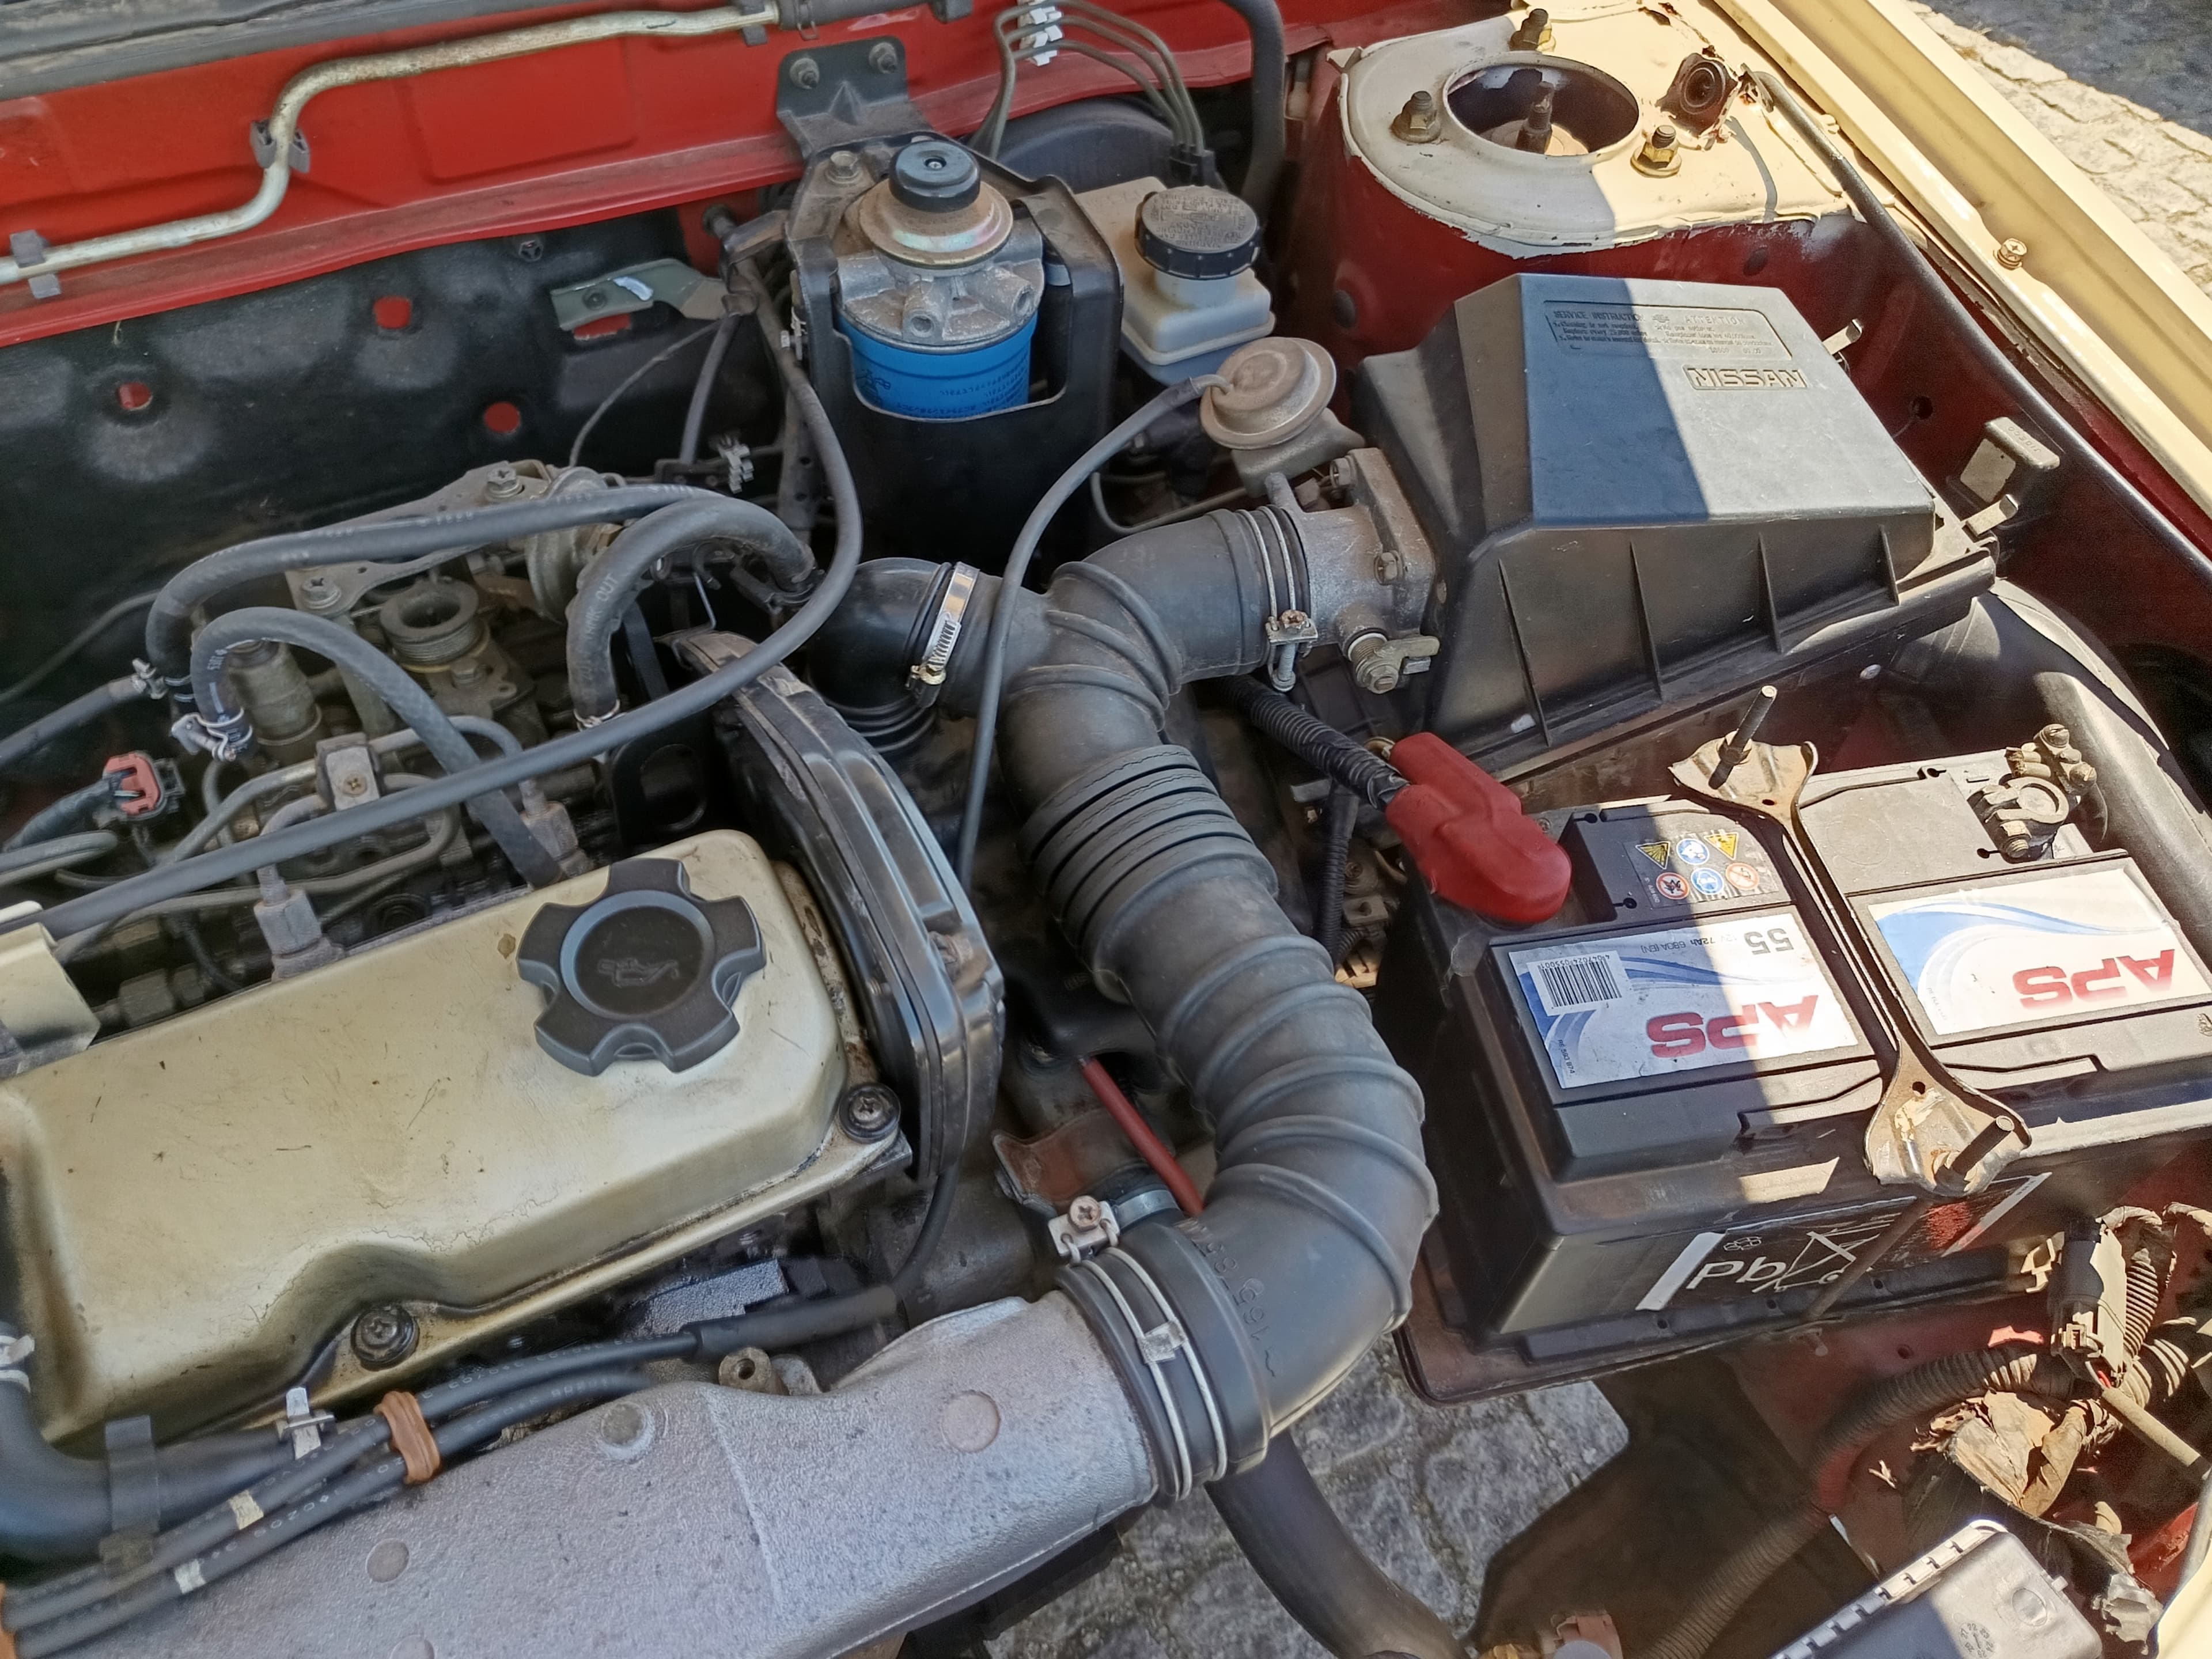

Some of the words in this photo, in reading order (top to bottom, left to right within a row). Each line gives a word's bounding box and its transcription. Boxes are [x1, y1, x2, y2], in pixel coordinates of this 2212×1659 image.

[1684, 316, 1745, 325] ATTENTION
[1687, 368, 1807, 387] NISSAN
[595, 573, 618, 601] OUT
[1660, 941, 1686, 950] 680A
[1690, 937, 1716, 946] 72Ah
[1744, 928, 1794, 955] 55
[2013, 949, 2175, 1010] APS
[1647, 995, 1819, 1058] APS
[1685, 1256, 1787, 1290] Pb
